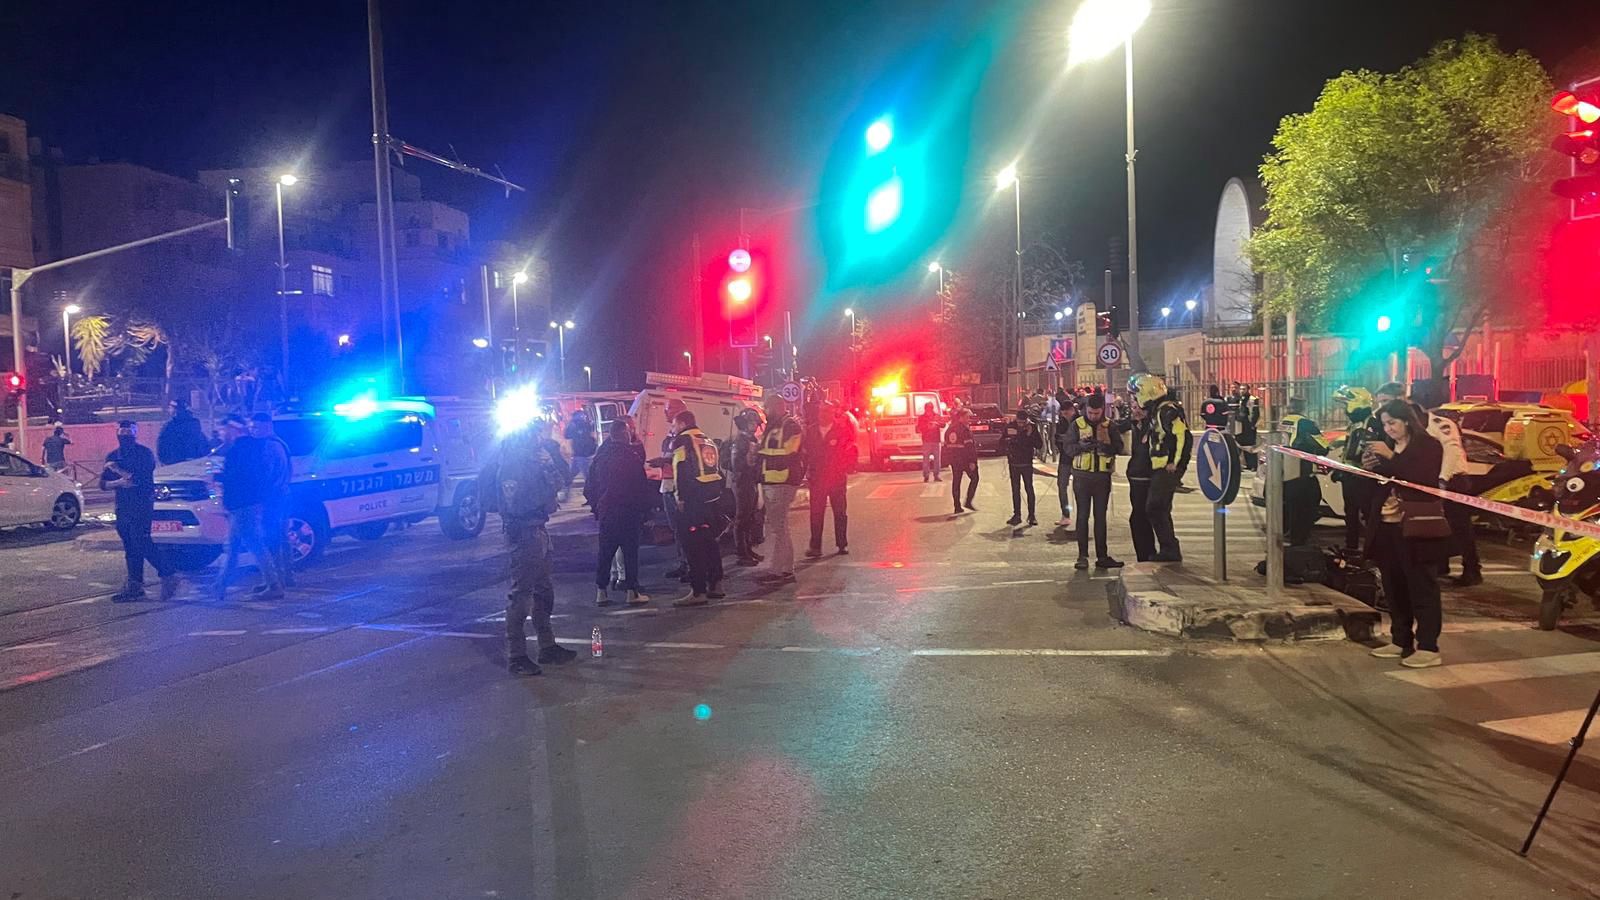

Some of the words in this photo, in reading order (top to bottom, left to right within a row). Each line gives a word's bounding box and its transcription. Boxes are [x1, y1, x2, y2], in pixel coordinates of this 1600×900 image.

[1102, 348, 1118, 360] 30
[784, 387, 799, 398] 30
[396, 470, 434, 486] משמר
[341, 476, 384, 494] הגבול
[358, 500, 388, 511] POLICE
